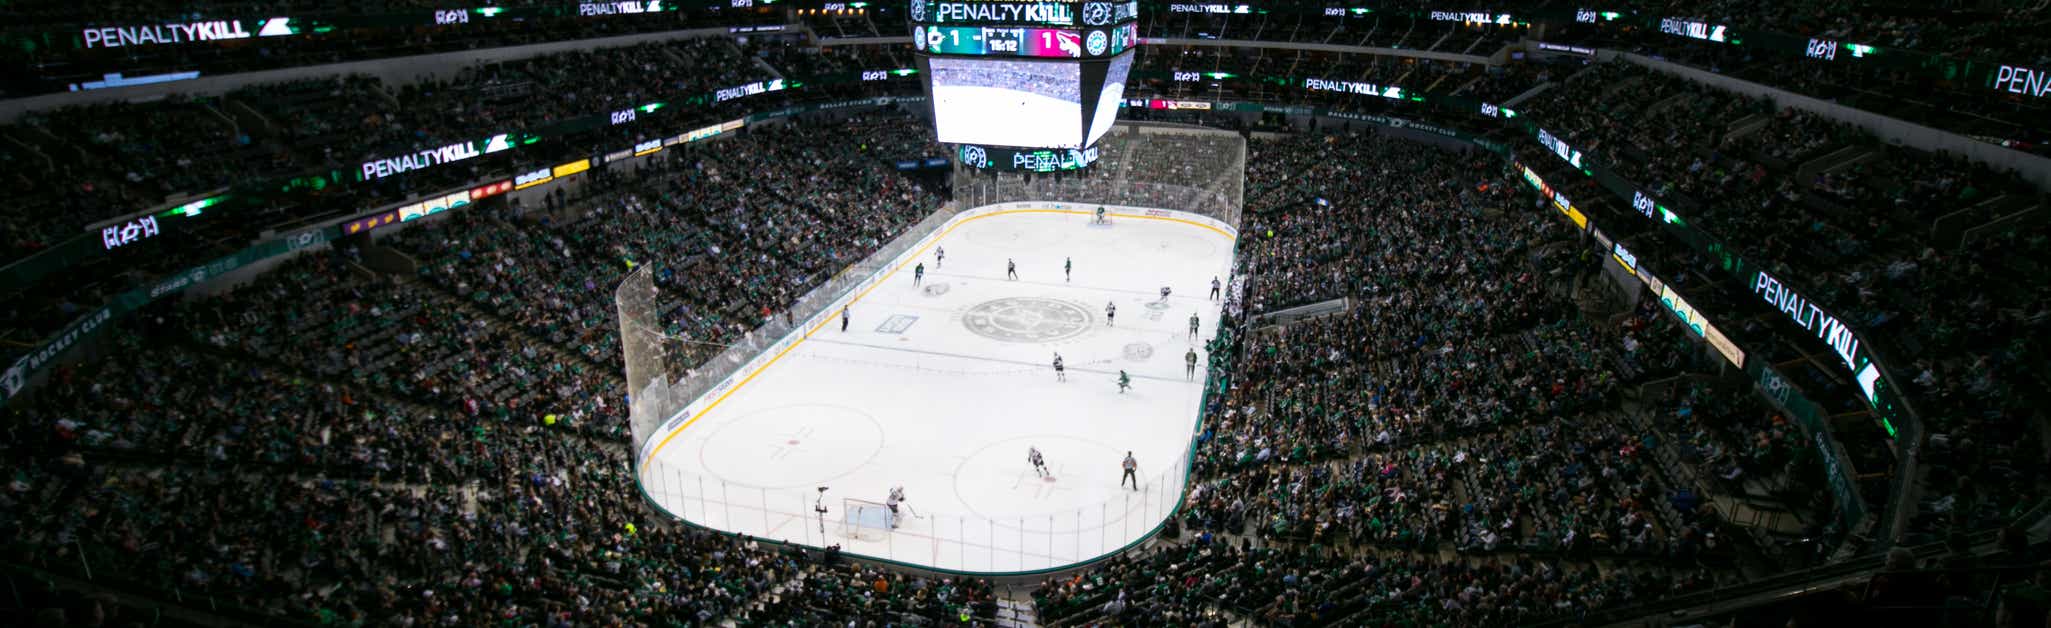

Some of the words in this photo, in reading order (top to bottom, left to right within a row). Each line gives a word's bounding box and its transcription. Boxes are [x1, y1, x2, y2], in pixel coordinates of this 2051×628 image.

[951, 30, 958, 45] 1
[1043, 32, 1051, 48] 1
[29, 329, 79, 369] HOCKEY
[81, 307, 111, 334] CLUB
